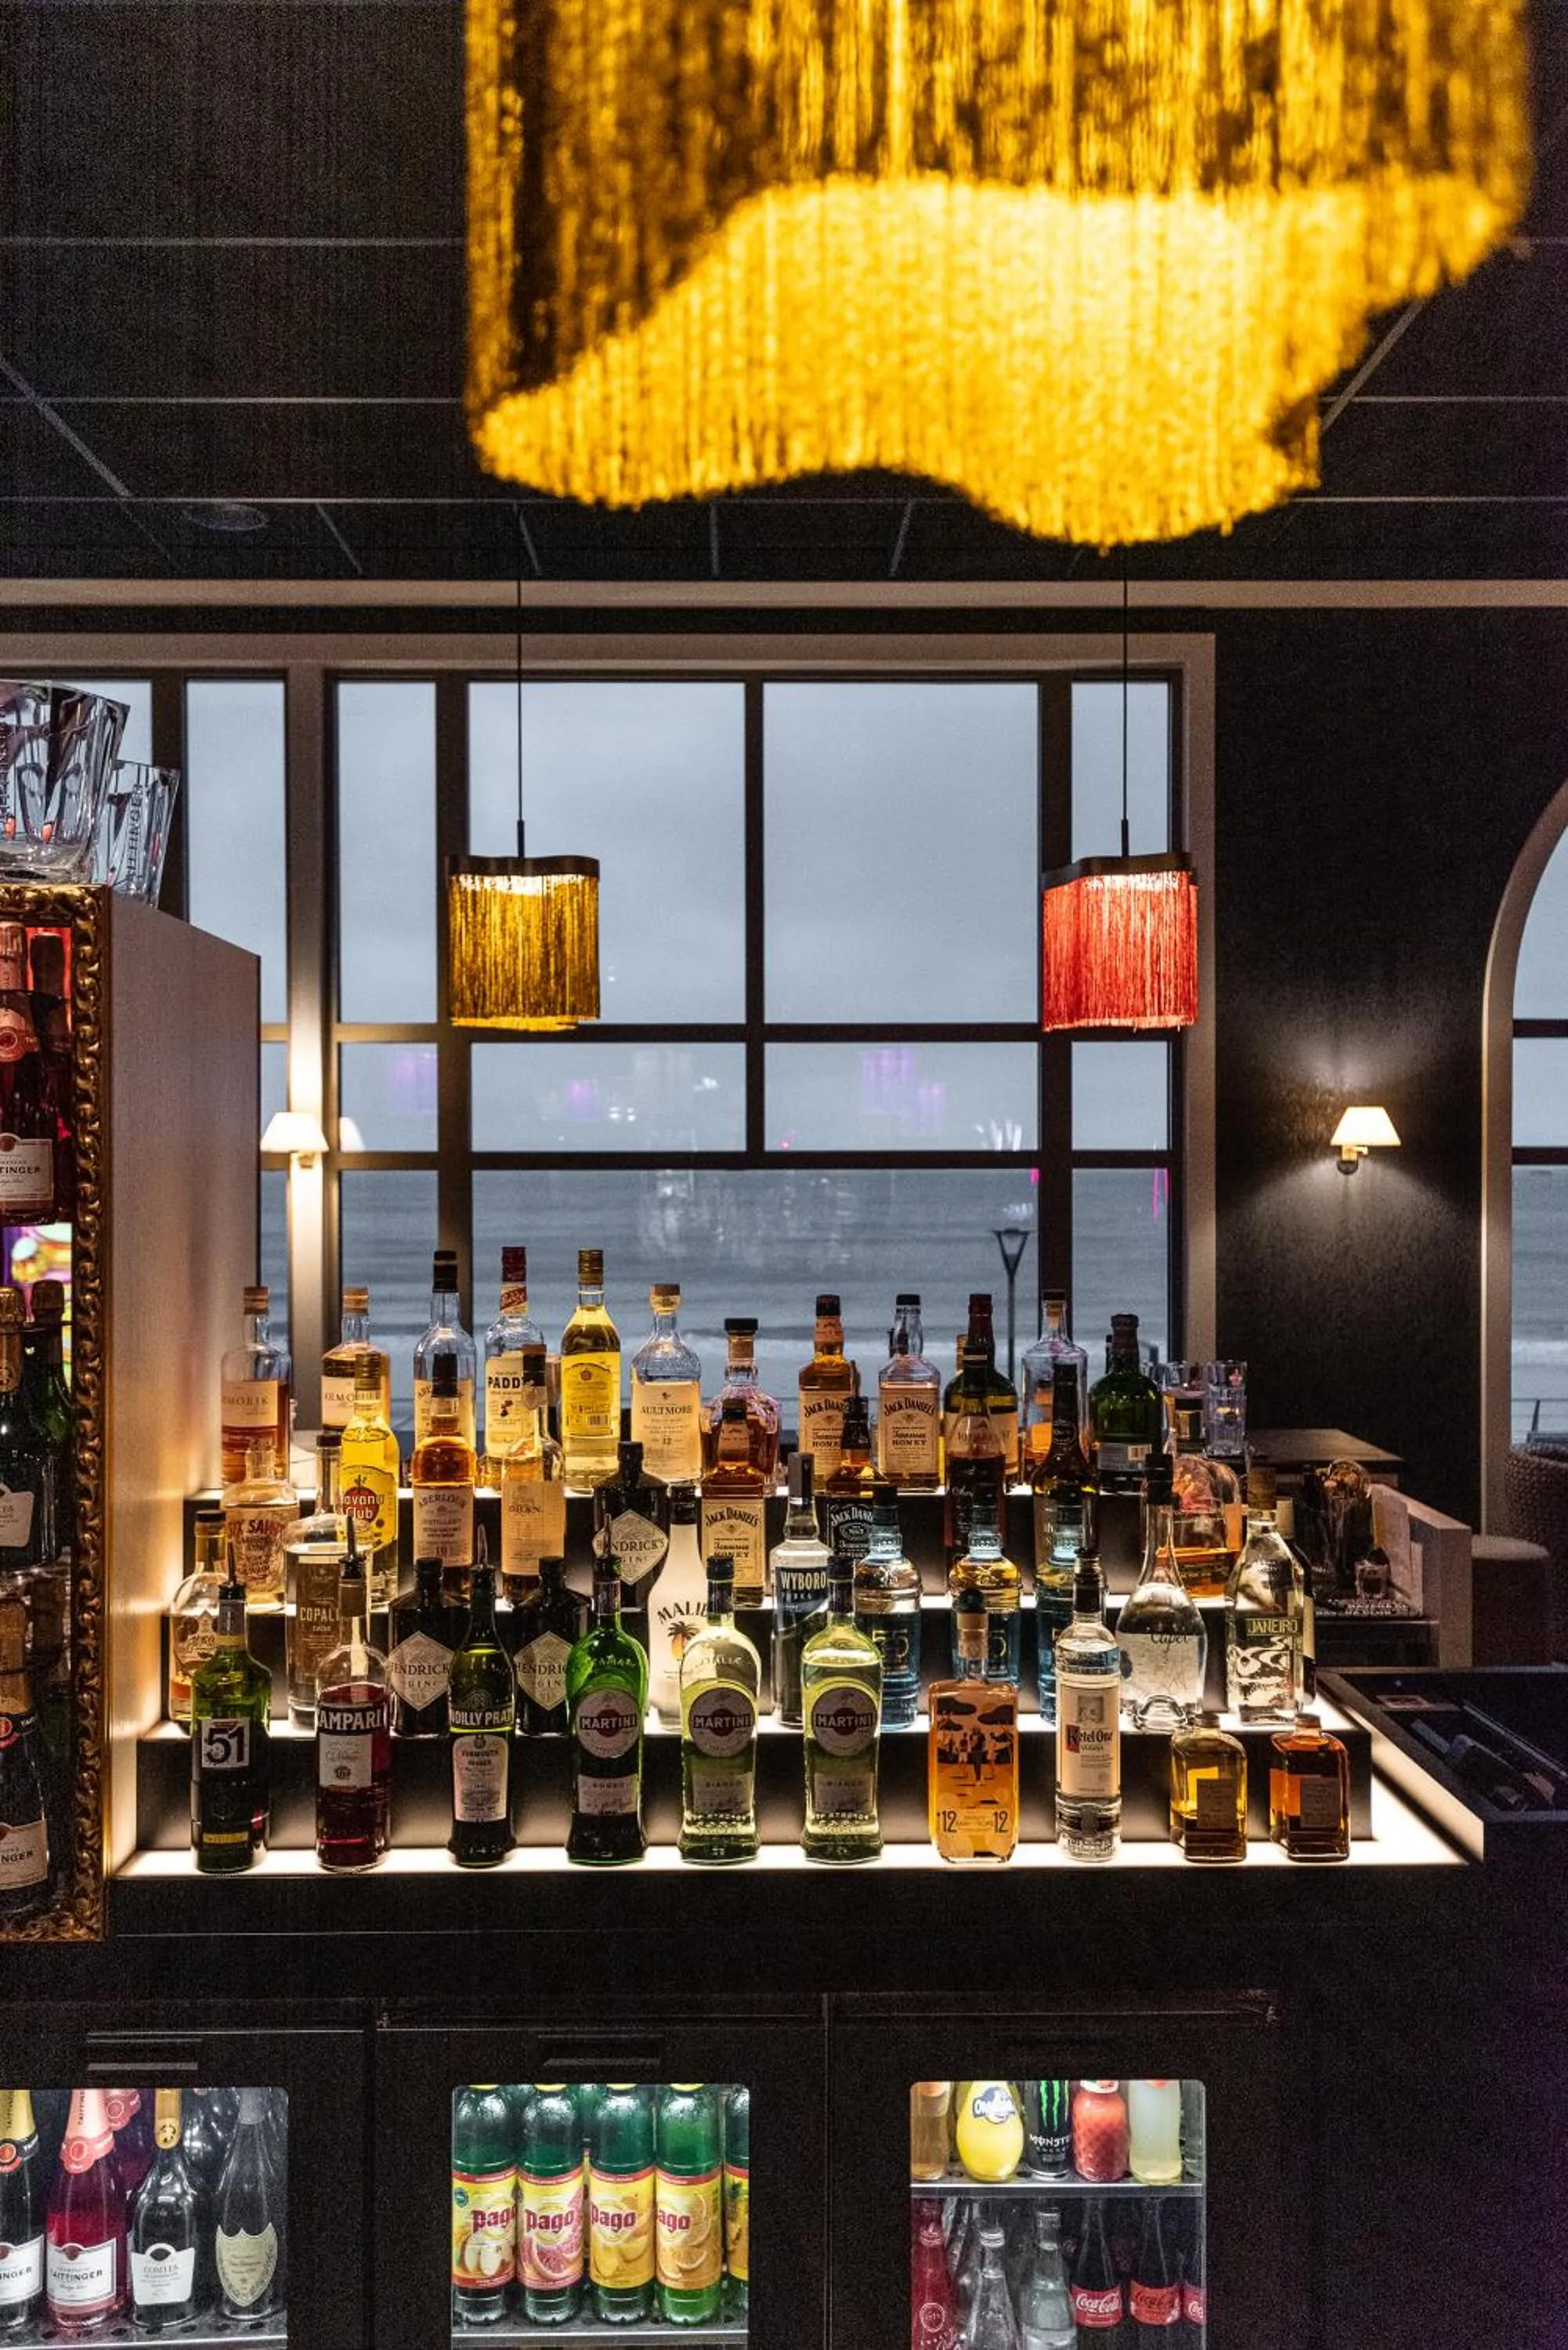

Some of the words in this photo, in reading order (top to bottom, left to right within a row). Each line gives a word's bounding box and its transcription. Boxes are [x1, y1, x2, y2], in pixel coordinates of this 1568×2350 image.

[705, 1510, 726, 1528] JACK
[780, 1571, 826, 1590] WYBORO
[657, 1600, 707, 1625] MALI
[1248, 1619, 1298, 1633] JANEIRO
[317, 1709, 382, 1730] AMPARI
[582, 1715, 636, 1728] MARTINI
[695, 1715, 750, 1727] MARTINI
[817, 1714, 873, 1727] MARTINI
[207, 1726, 245, 1763] 51
[942, 1810, 958, 1833] 12
[993, 1810, 1009, 1833] 12
[525, 2209, 576, 2232] pago
[658, 2210, 691, 2232] ago
[1075, 2293, 1121, 2312] Coca-Cola
